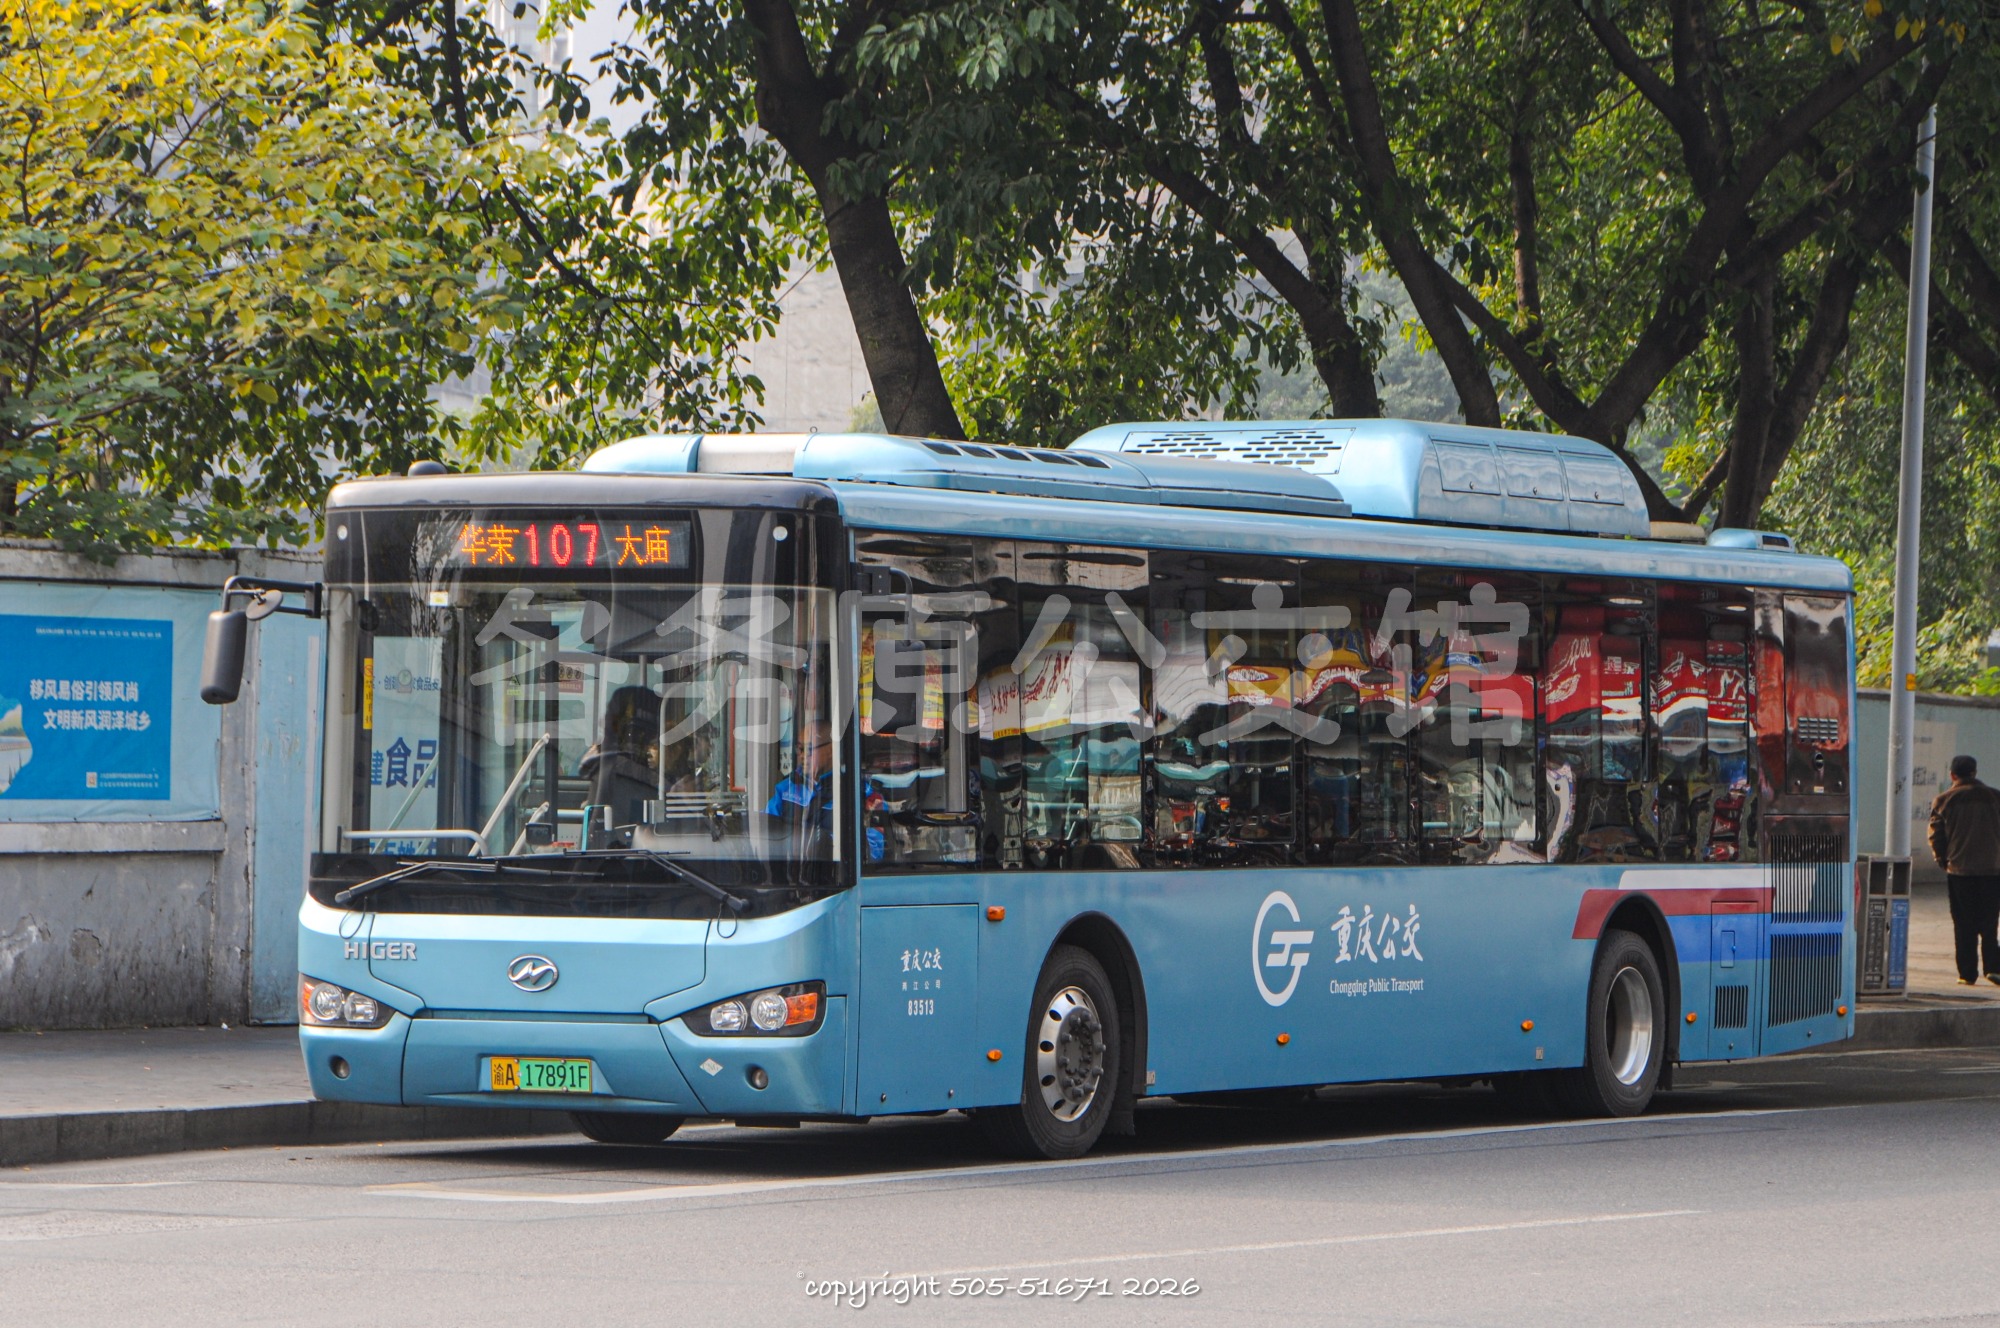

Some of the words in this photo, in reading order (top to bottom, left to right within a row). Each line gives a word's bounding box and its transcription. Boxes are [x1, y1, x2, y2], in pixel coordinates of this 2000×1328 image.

[458, 523, 520, 566] 华荣
[524, 523, 599, 567] 107
[615, 524, 671, 567] 大庙
[29, 678, 139, 702] 移风易俗引领风尚
[43, 708, 152, 731] 文明新风润泽城乡
[1331, 903, 1424, 964] 重庆公交
[344, 941, 417, 961] HIGER
[900, 947, 943, 973] 重庆公交
[1329, 979, 1368, 998] Chongqing
[1368, 979, 1390, 993] Public
[1391, 978, 1424, 995] Transport
[907, 999, 935, 1016] 83513
